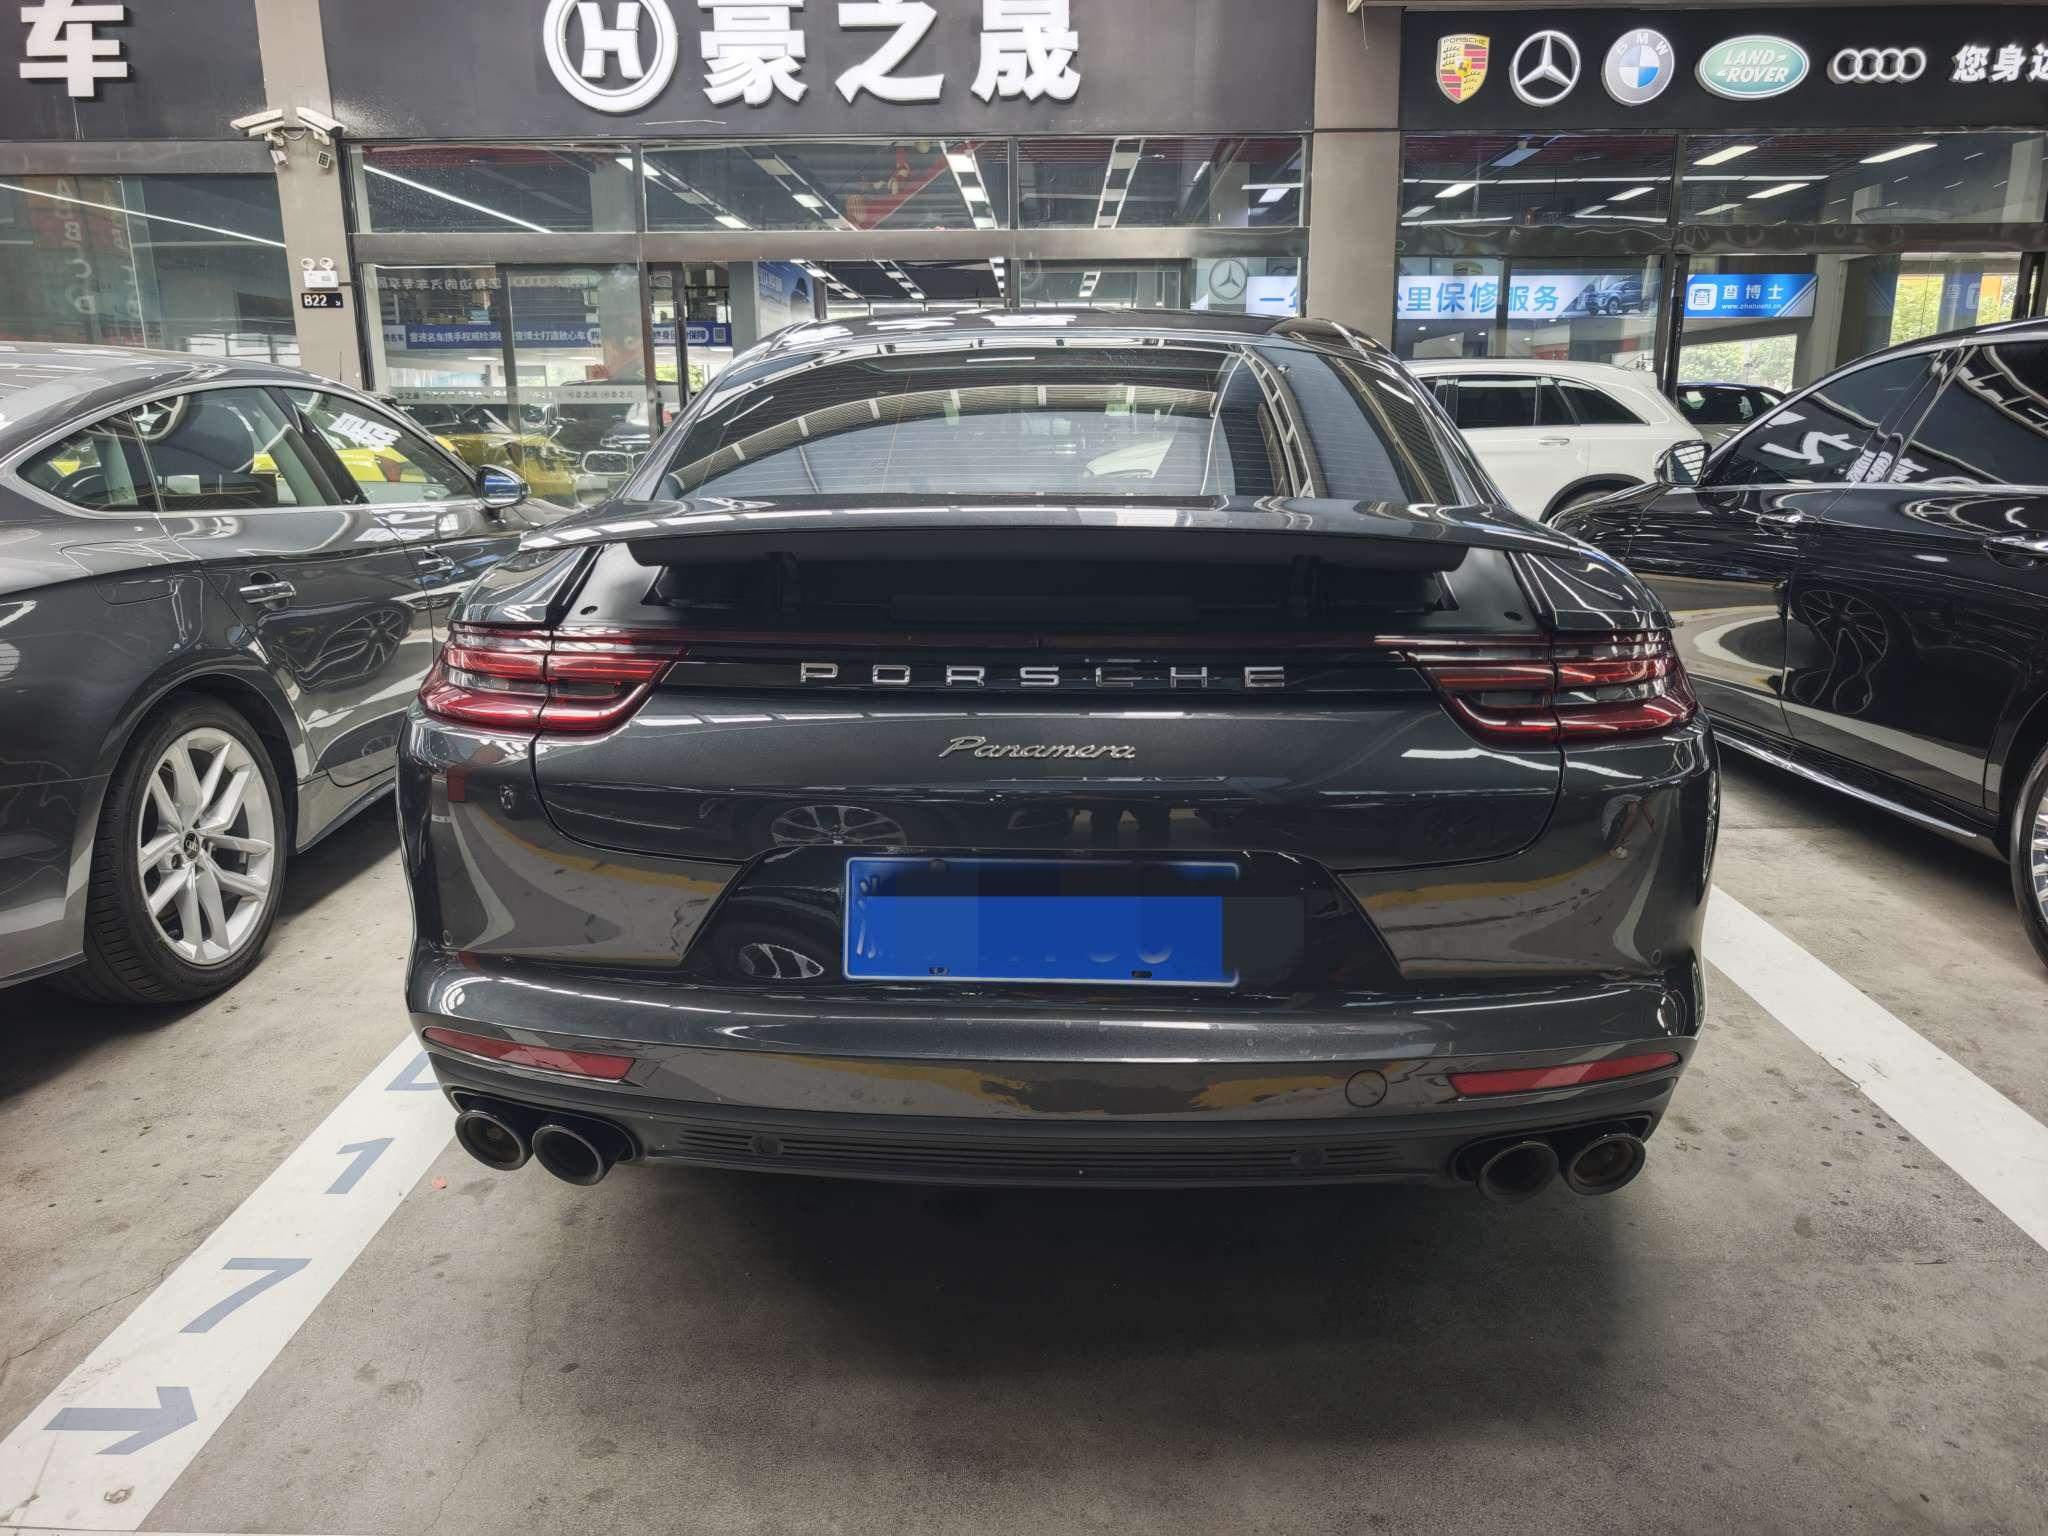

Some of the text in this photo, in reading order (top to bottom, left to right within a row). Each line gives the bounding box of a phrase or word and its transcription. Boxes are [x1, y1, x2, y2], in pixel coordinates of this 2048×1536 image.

[20, 0, 128, 97] 车
[700, 0, 1081, 105] 豪之晟
[1615, 32, 1670, 57] BMW
[1723, 49, 1775, 66] LAND
[1726, 67, 1790, 83] ROVER
[304, 294, 328, 307] B22
[1398, 281, 1559, 313] 里保修服务
[1721, 284, 1784, 300] 查博士
[800, 662, 1285, 688] PORSCHE
[938, 735, 1137, 759] Panamera
